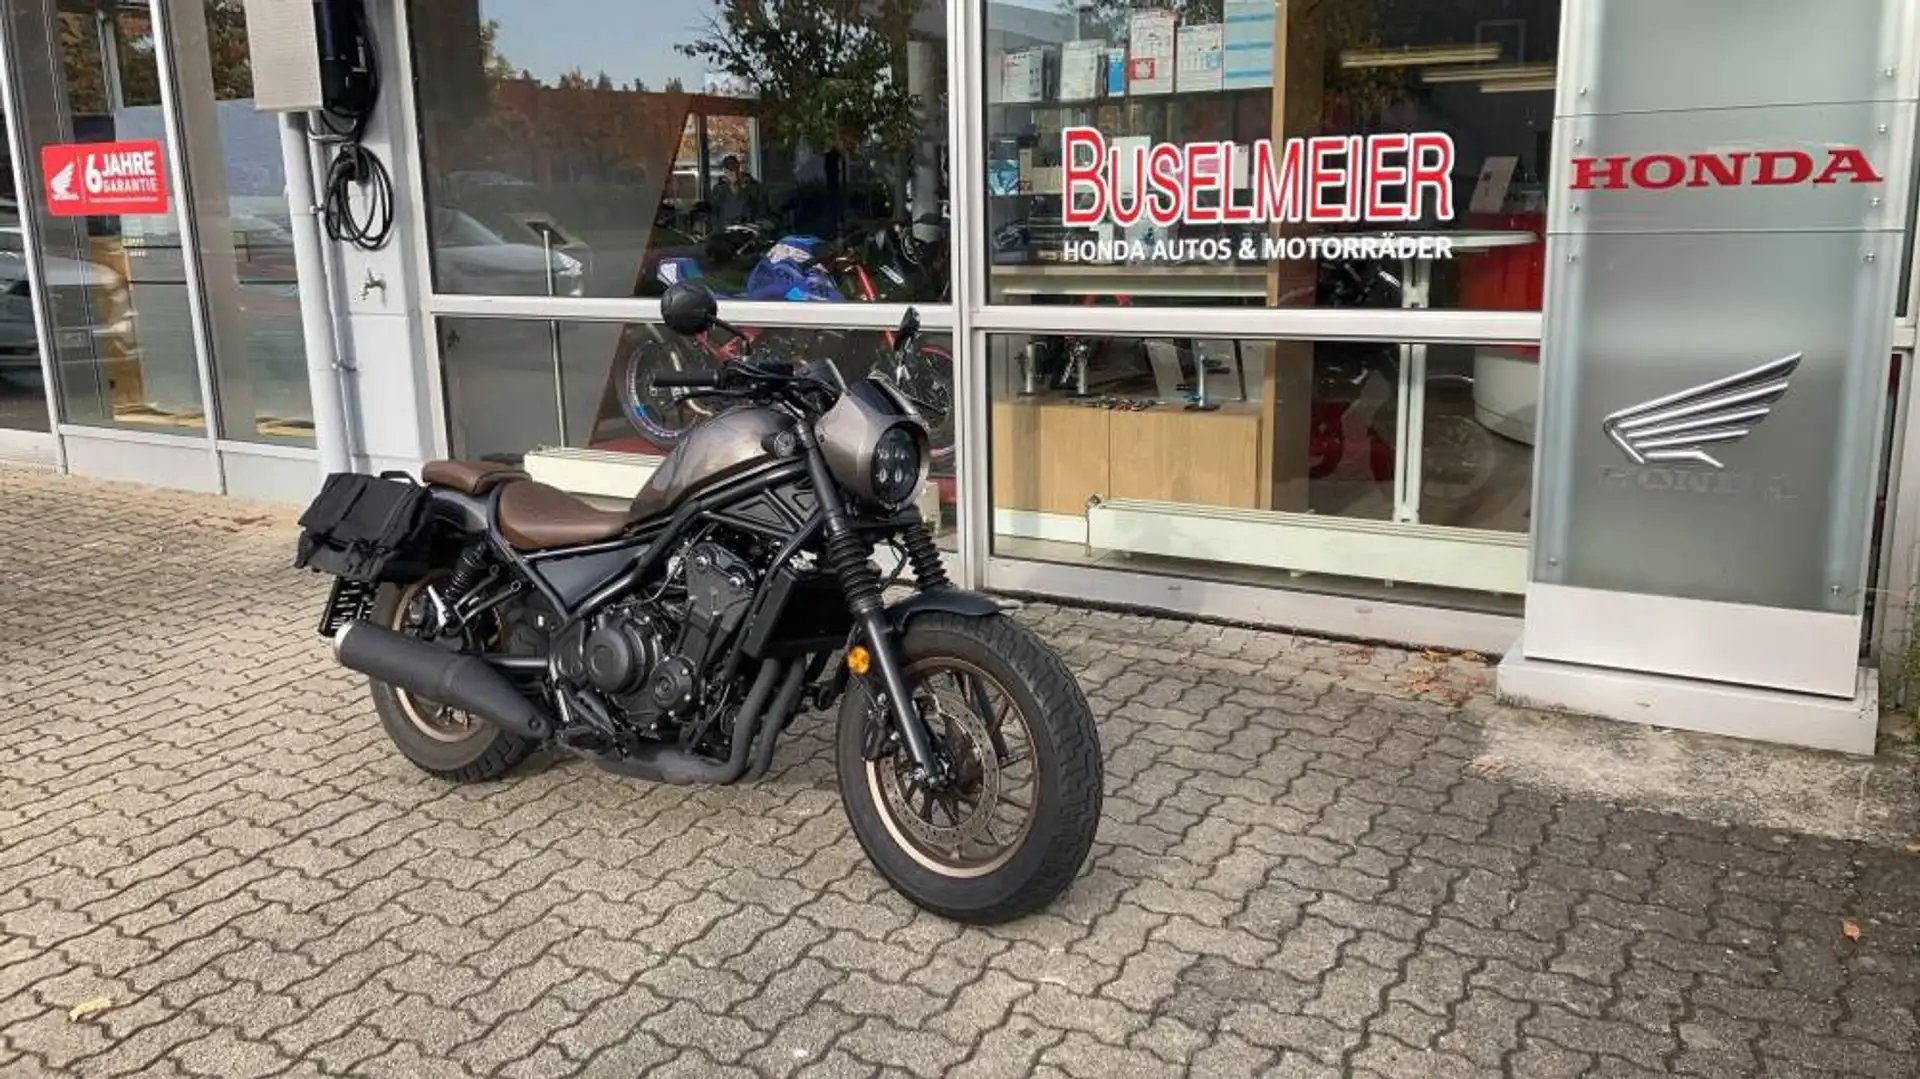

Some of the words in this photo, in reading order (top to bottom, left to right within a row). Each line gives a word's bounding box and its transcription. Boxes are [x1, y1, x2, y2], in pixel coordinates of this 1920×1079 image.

[85, 153, 102, 193] 6
[102, 151, 156, 178] JAHRE
[103, 178, 157, 193] GARANTIE
[1062, 126, 1455, 227] BUSELMEIER
[1568, 148, 1883, 190] HONDA
[1064, 239, 1146, 261] HONDA
[1152, 237, 1232, 260] AUTOS
[1238, 238, 1257, 260] &
[1264, 232, 1453, 260] MOTORRÄDER
